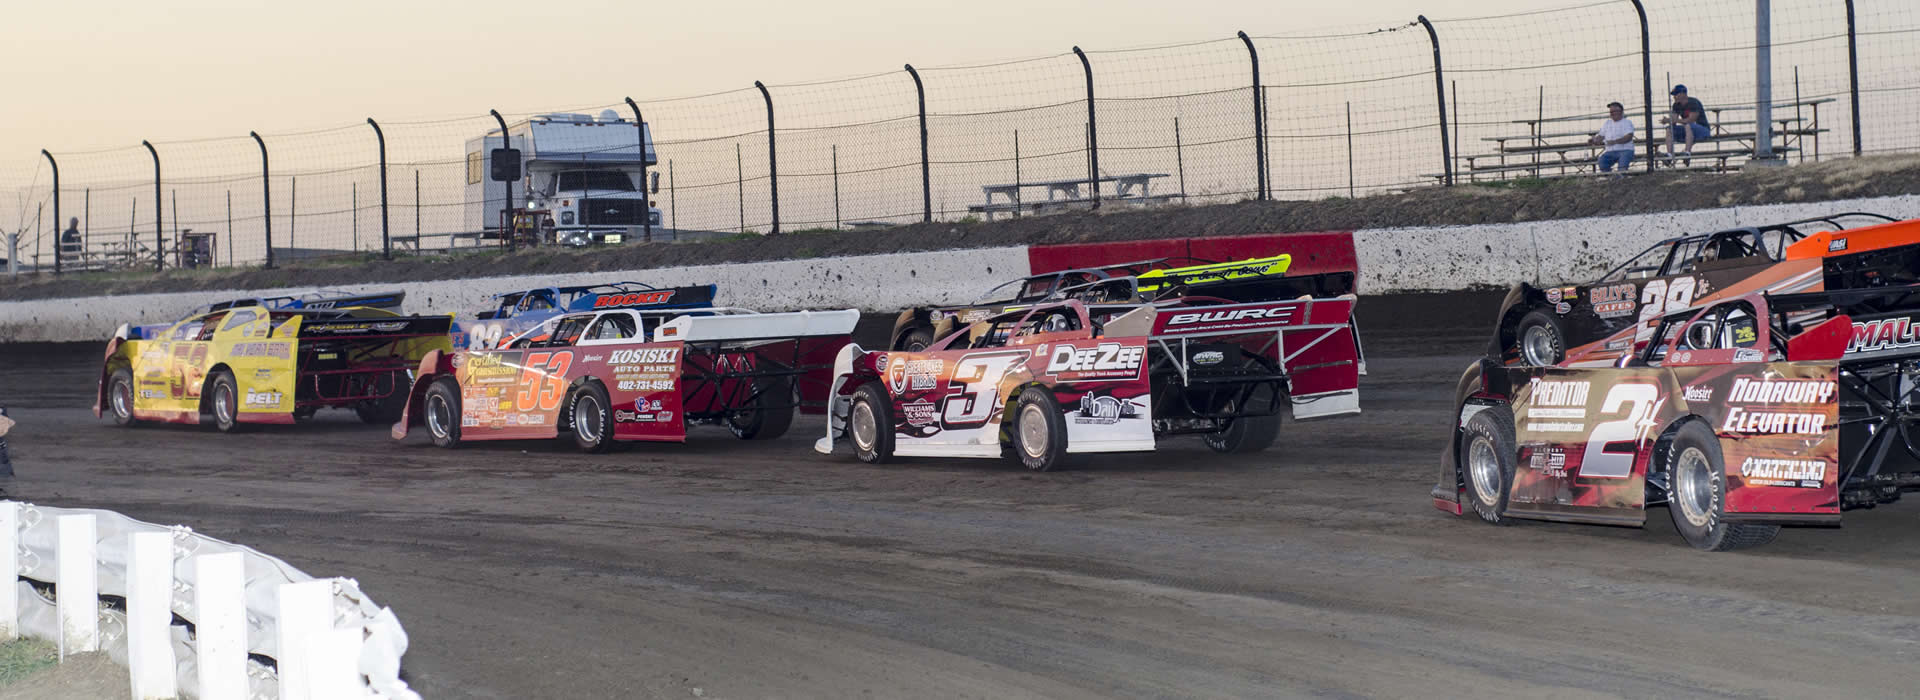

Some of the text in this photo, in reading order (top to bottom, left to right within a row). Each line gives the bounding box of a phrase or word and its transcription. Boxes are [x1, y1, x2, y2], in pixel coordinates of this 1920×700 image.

[594, 291, 676, 308] ROCKET
[1591, 284, 1636, 304] BILLY'S
[1167, 306, 1297, 325] BWRC
[1596, 302, 1633, 312] CAFES
[607, 348, 681, 364] KOSISKI
[613, 365, 676, 373] AUTO PARTS
[517, 351, 574, 411] 53
[617, 379, 675, 391] 402-731-4592
[940, 348, 1031, 430] 3
[1529, 377, 1591, 406] PREDATOR
[1682, 385, 1714, 401] Hoosier
[904, 405, 935, 413] WILLIAMS
[915, 411, 931, 419] SONS
[1092, 401, 1121, 424] Daily
[1723, 407, 1827, 435] ELEVATOR
[1751, 458, 1827, 481] NORTHLAND
